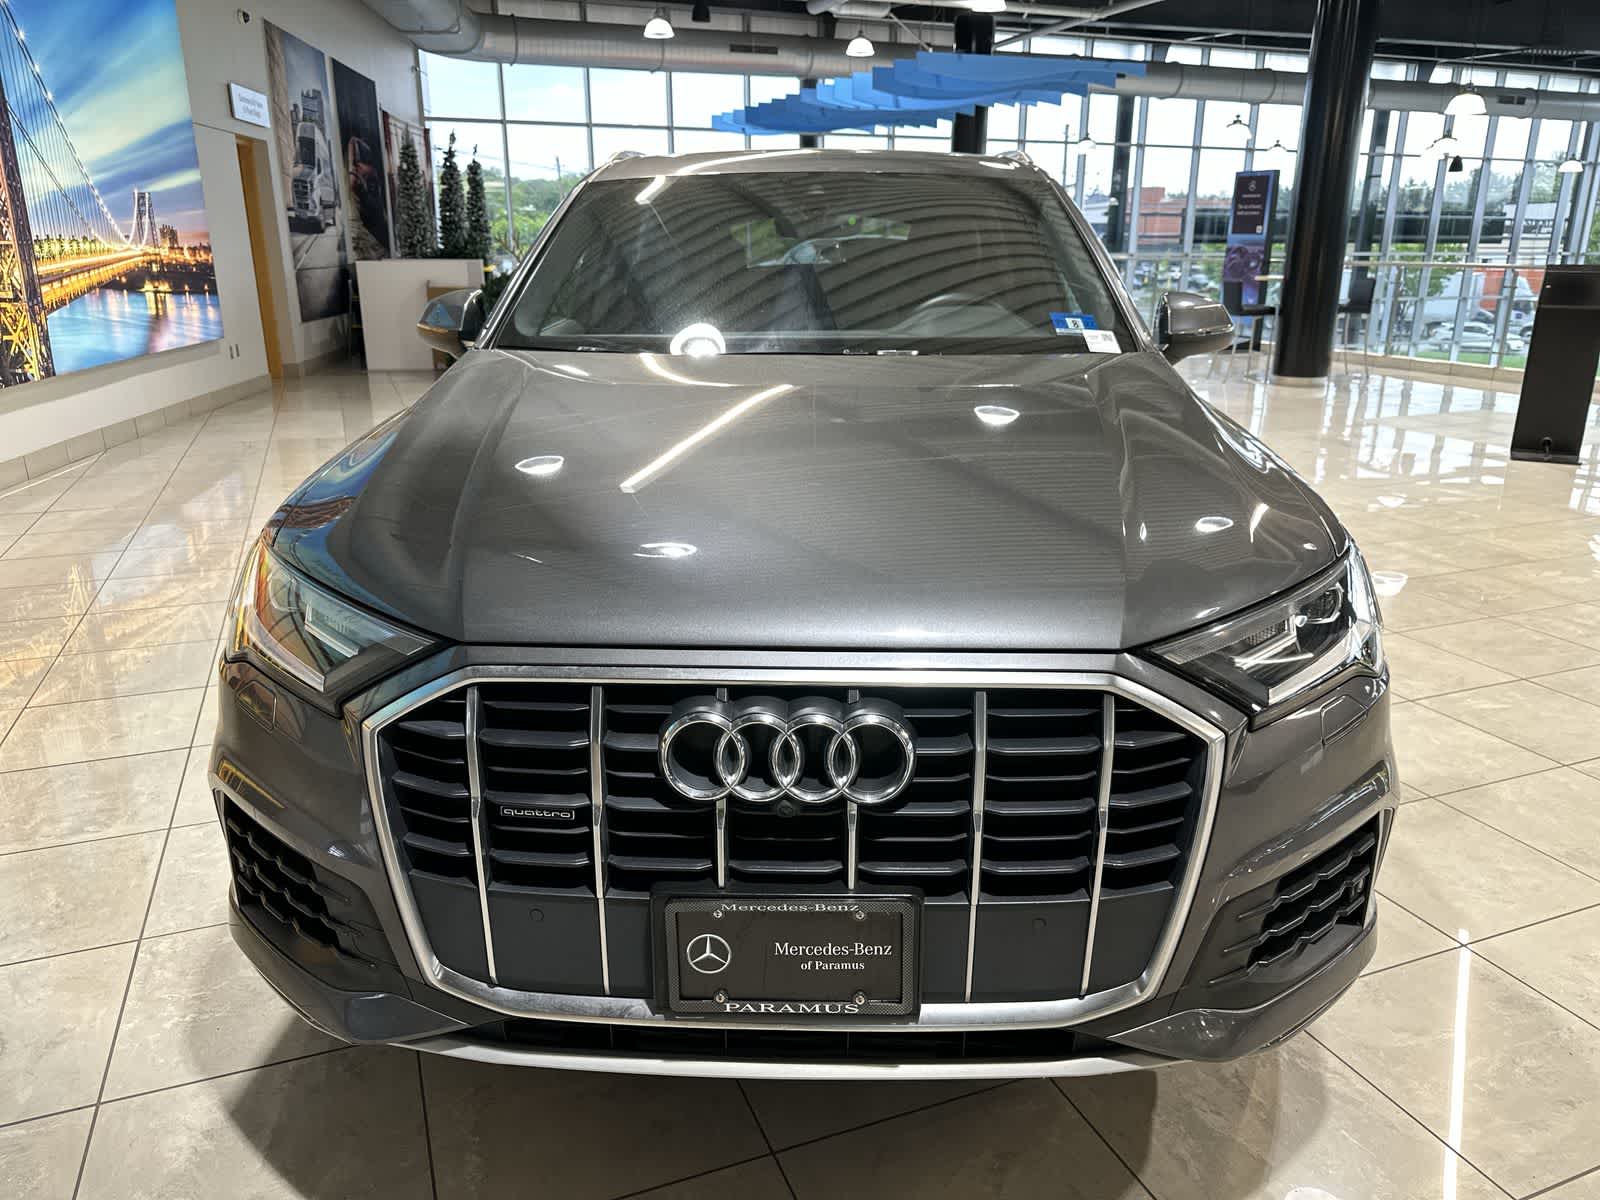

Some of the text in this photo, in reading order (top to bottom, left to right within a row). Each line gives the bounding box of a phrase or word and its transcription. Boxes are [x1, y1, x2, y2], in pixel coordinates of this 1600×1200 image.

[503, 808, 571, 818] quattro
[720, 904, 860, 912] Mercedes-Benz
[774, 942, 893, 956] Mercedes-Benz
[800, 960, 865, 970] of Paramus
[723, 1003, 859, 1014] PARAMUS
